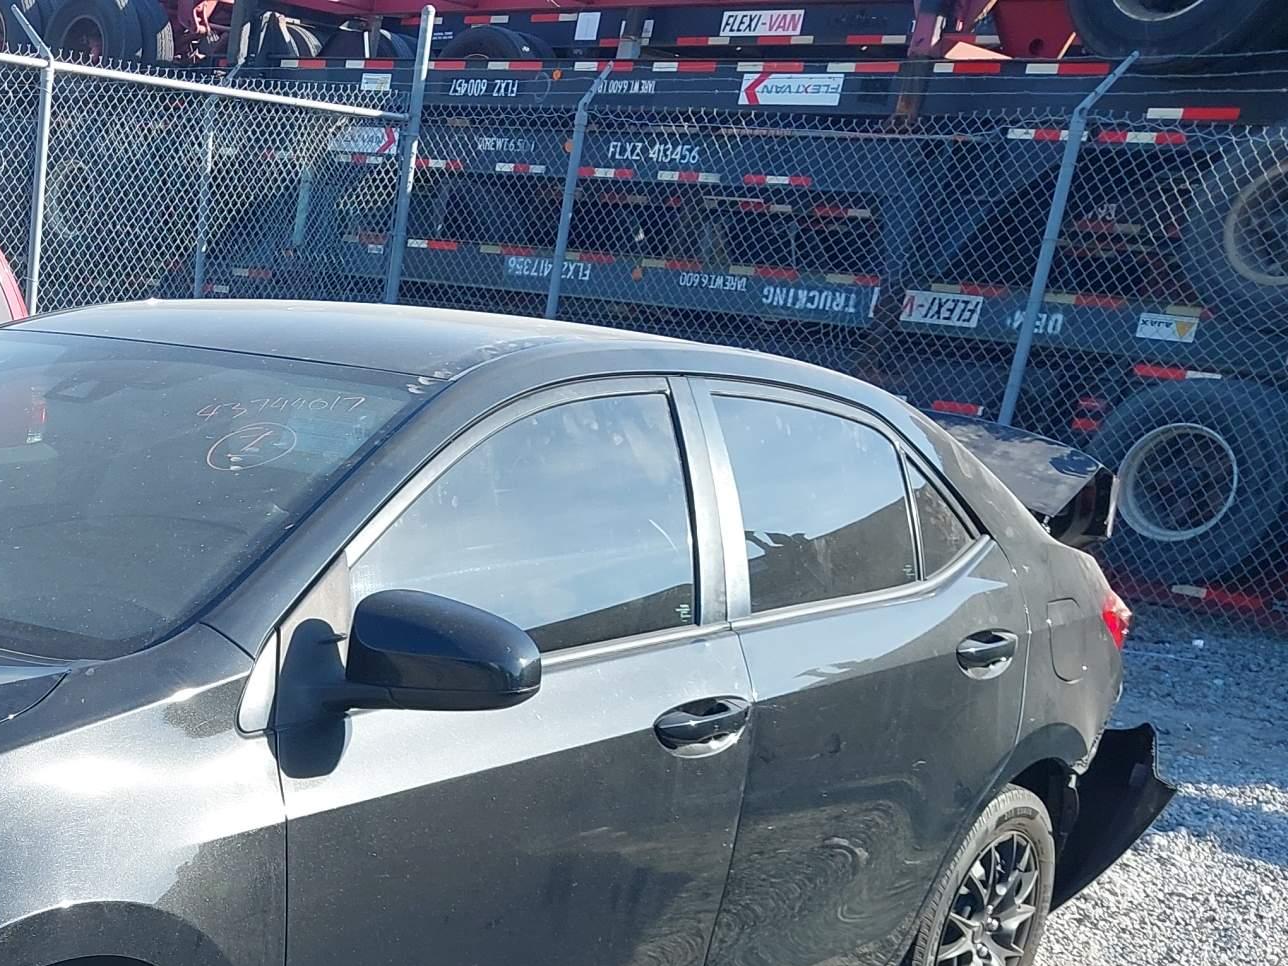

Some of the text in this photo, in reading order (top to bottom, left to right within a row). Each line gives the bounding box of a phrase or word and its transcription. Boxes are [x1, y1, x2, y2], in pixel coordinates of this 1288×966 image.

[722, 13, 801, 32] FLEXI-VAN
[449, 79, 518, 97] FLXZ 600457
[608, 141, 700, 164] FLXZ 413456
[761, 285, 857, 313] TRUCKING
[902, 295, 981, 323] FLEXI-V
[196, 394, 365, 422] 43744017
